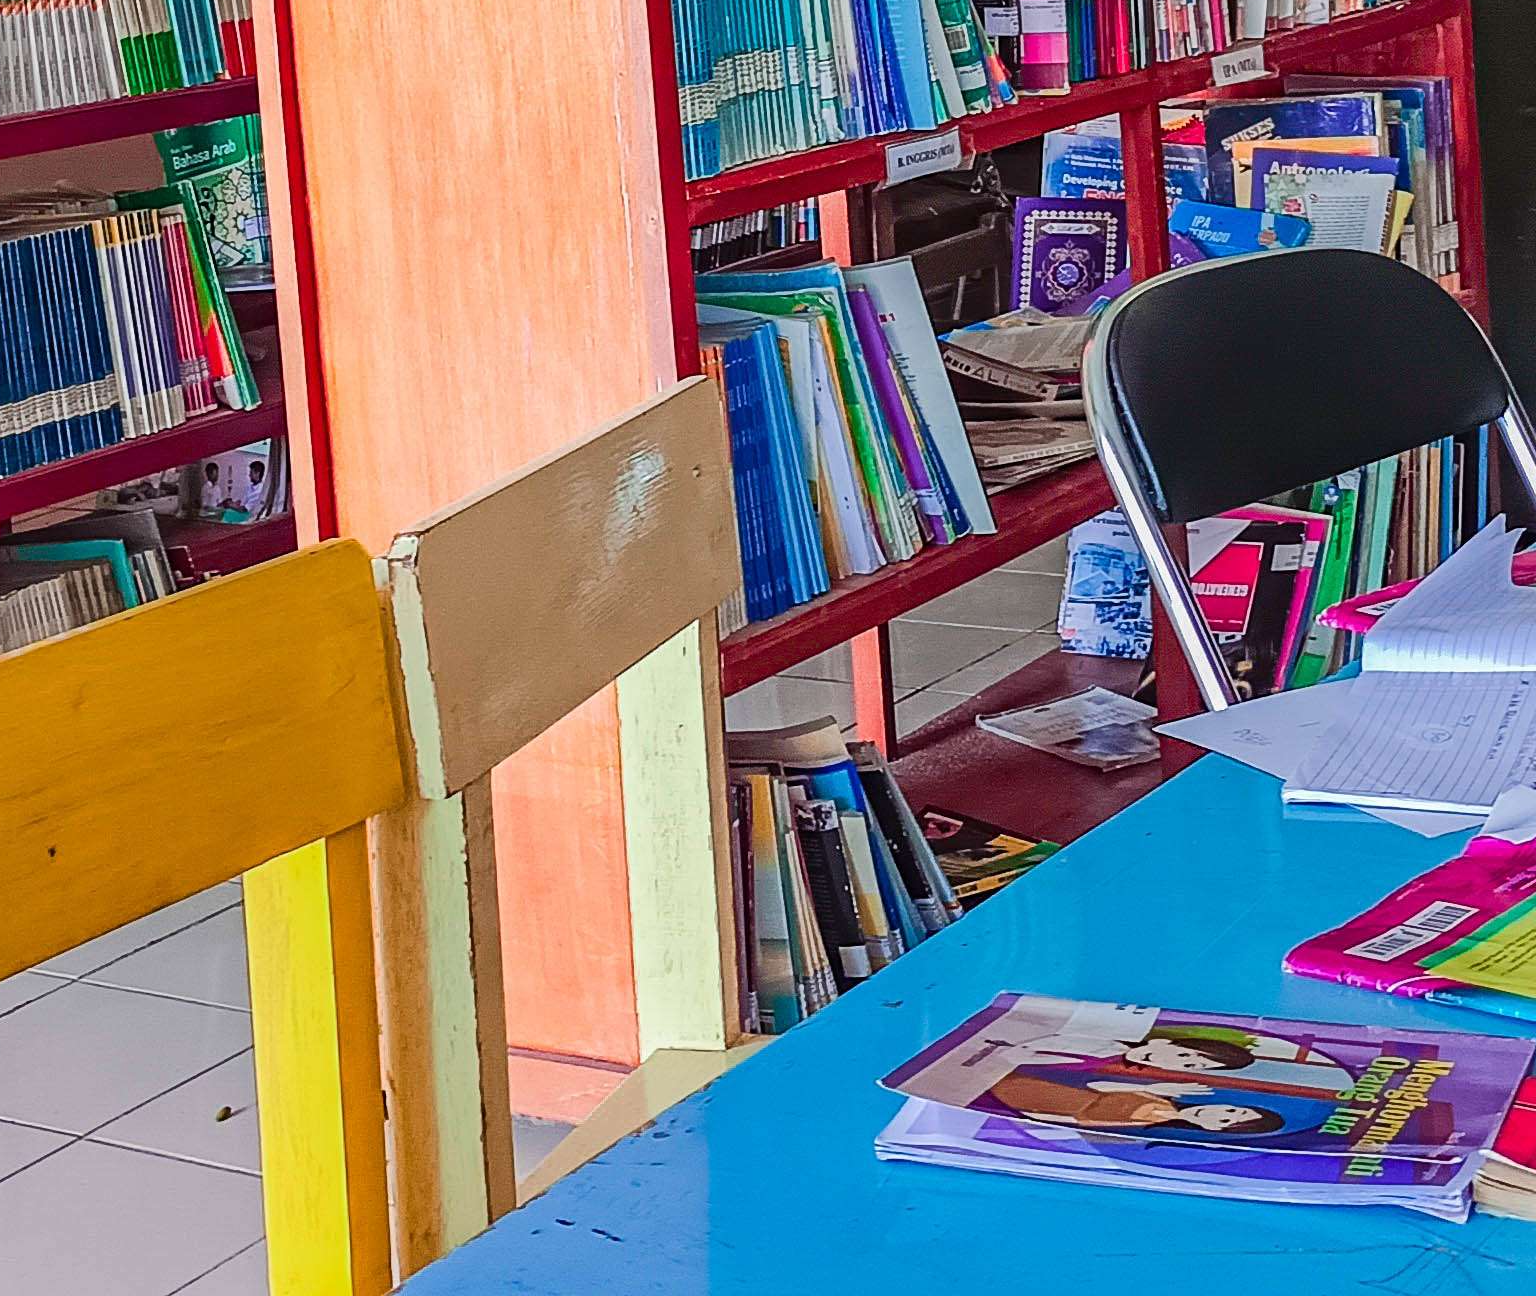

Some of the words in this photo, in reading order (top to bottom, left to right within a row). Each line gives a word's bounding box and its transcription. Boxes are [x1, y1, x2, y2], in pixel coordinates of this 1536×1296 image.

[172, 148, 211, 171] Bahasa
[211, 139, 237, 159] Arab
[907, 150, 936, 166] INGGRIS
[1063, 173, 1118, 191] Developing
[1191, 215, 1211, 229] IPA
[1336, 1056, 1411, 1103] Orang
[1318, 1107, 1377, 1135] Tua
